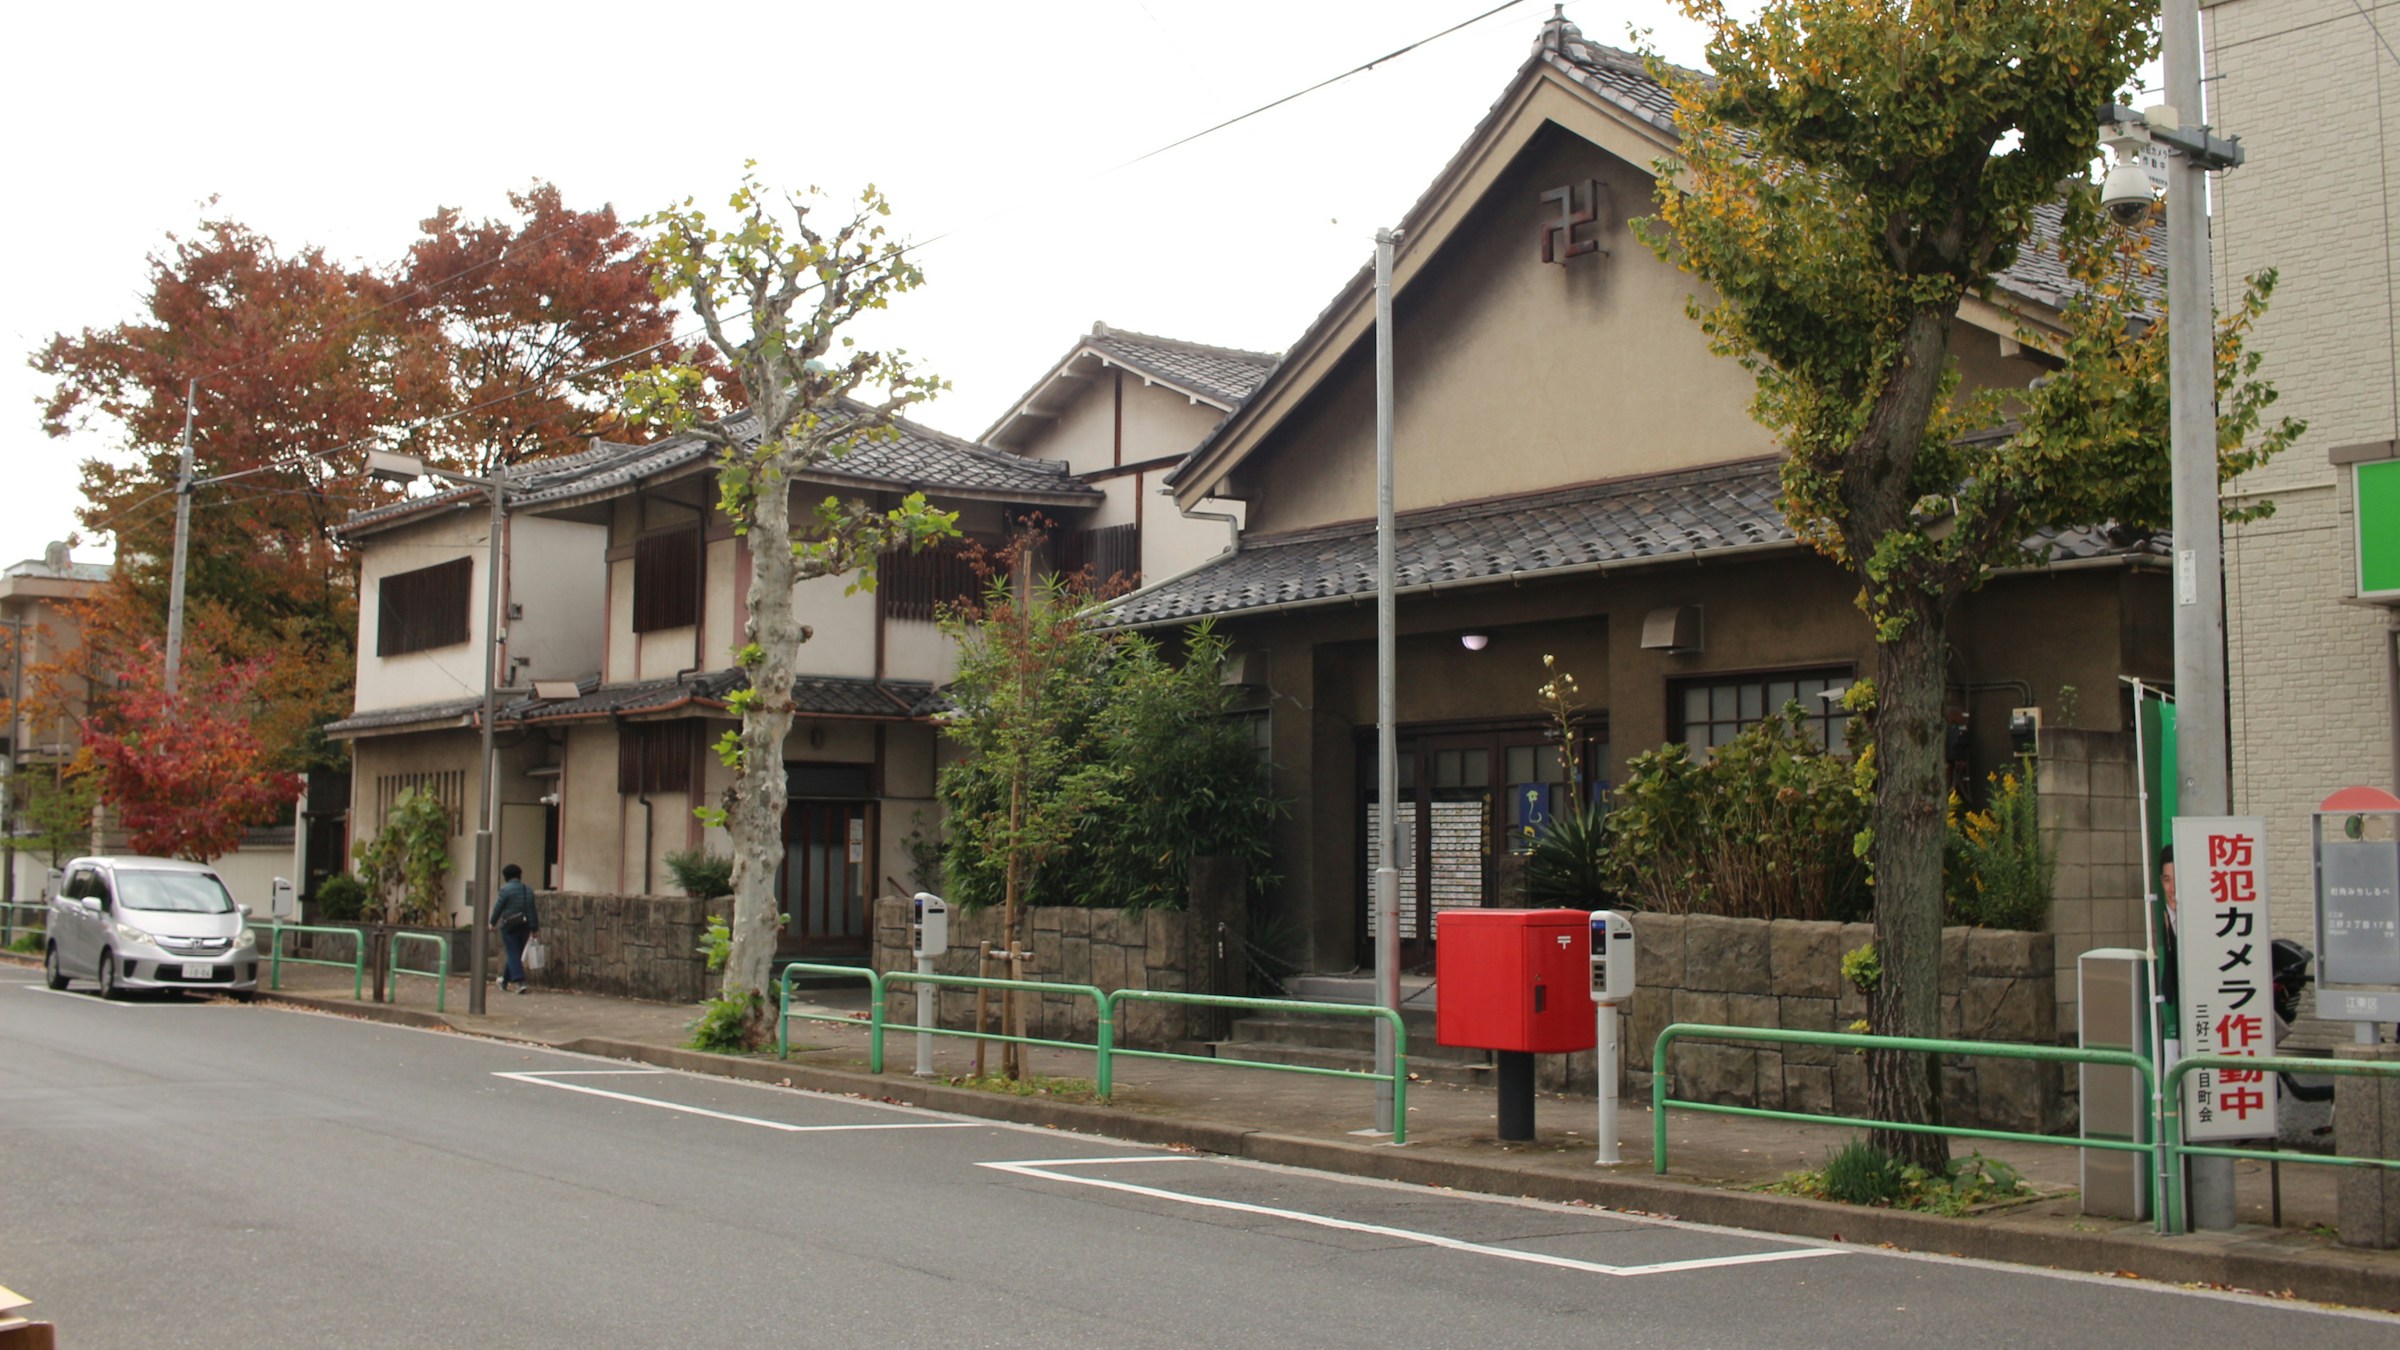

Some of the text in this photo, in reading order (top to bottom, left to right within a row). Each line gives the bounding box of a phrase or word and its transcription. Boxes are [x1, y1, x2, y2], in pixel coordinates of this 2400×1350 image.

[2196, 1004, 2212, 1123] 三好二目町会
[2208, 834, 2264, 1121] 防犯カメラ作動中
